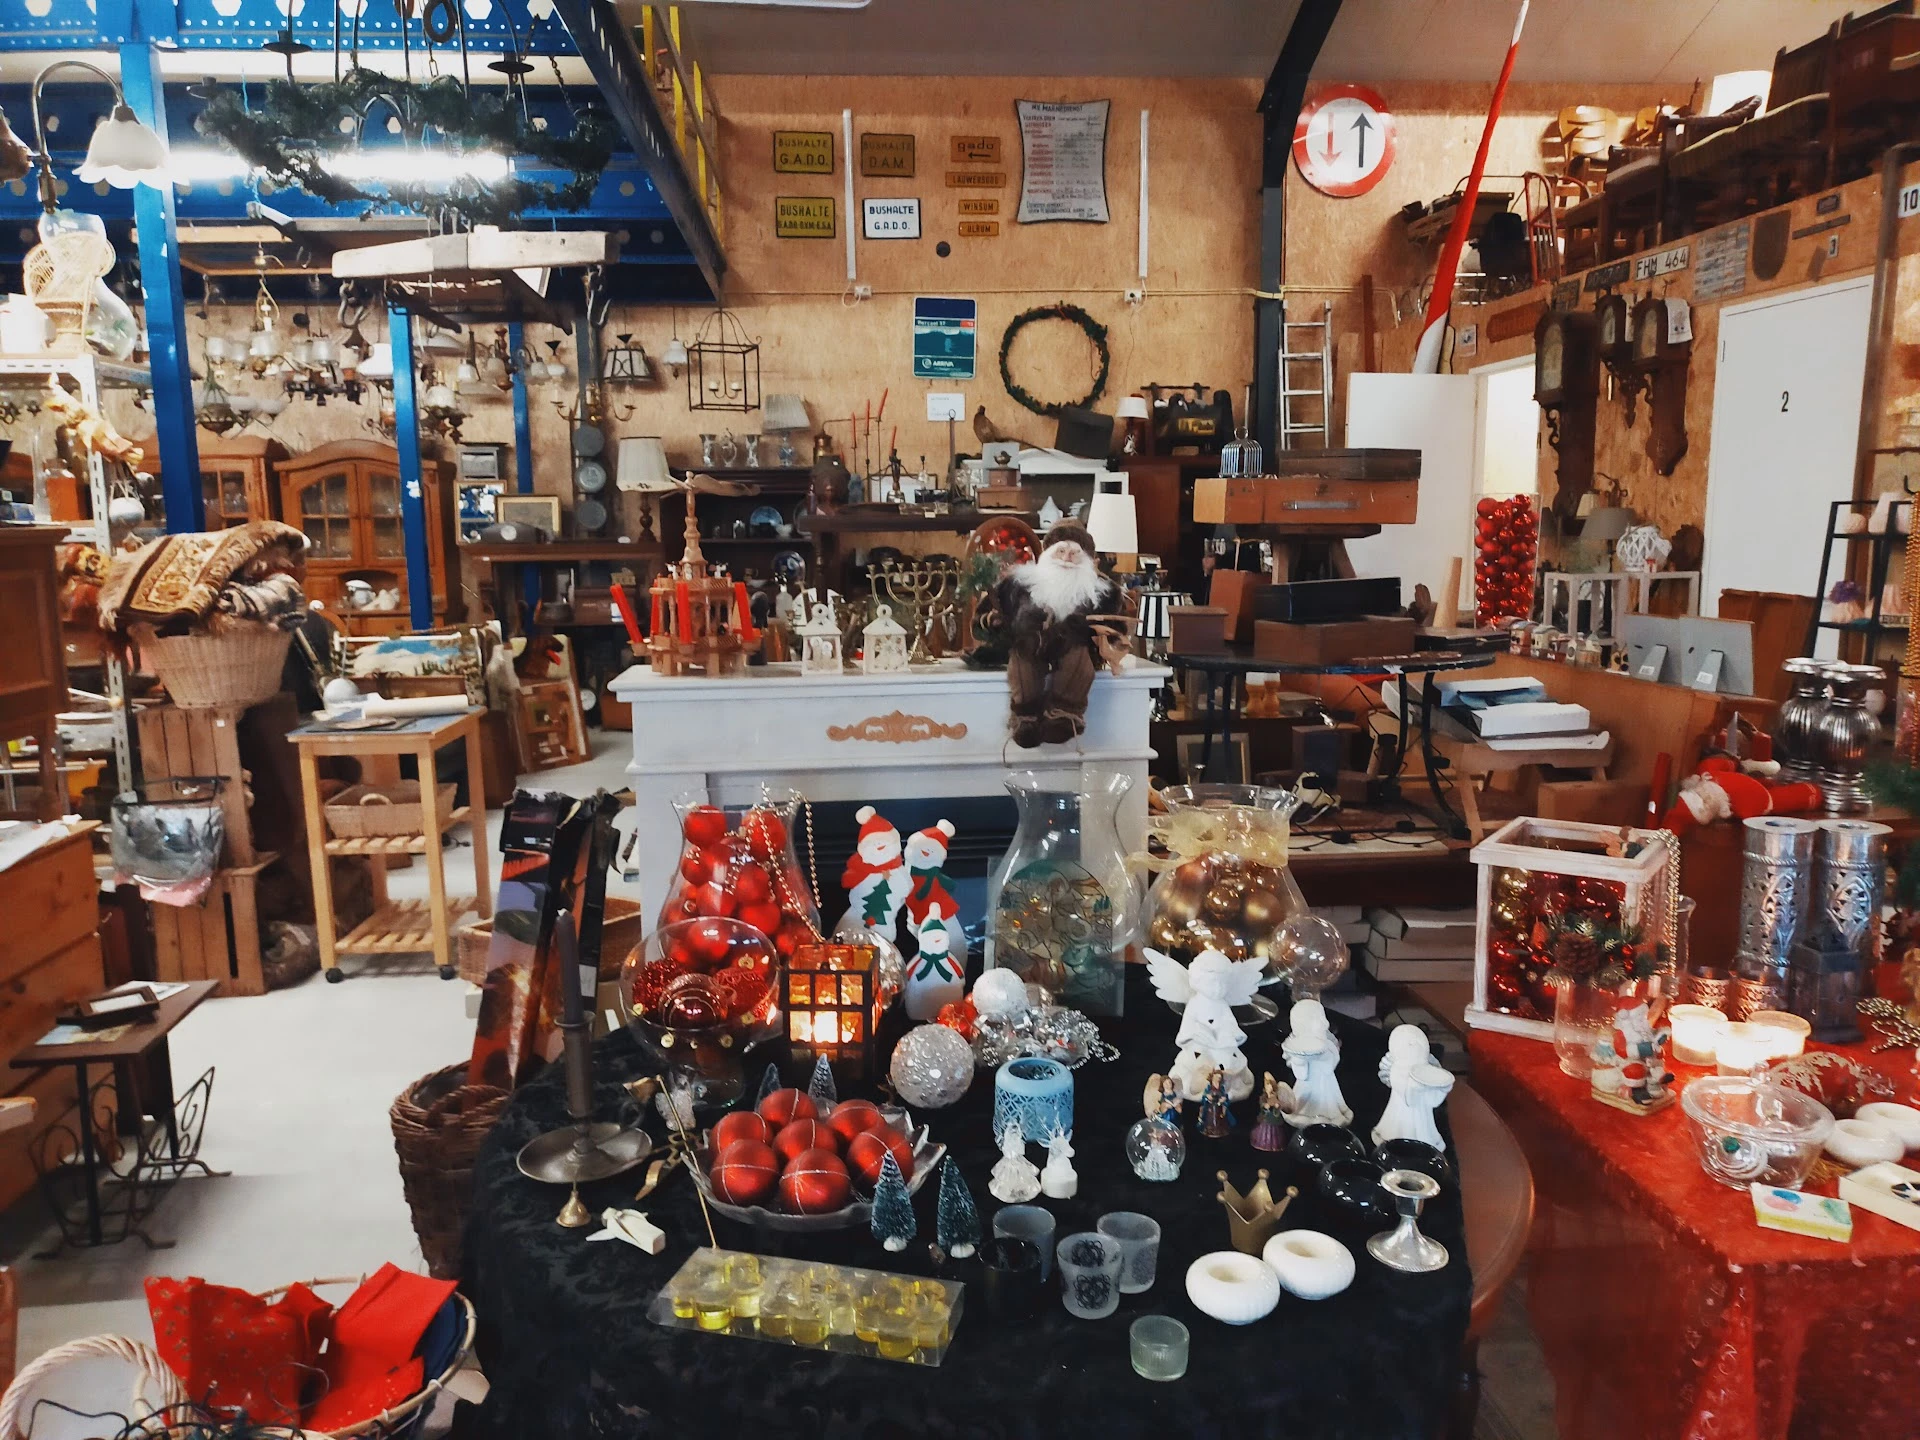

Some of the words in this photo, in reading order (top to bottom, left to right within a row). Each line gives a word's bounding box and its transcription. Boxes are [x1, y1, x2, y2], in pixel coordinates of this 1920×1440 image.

[779, 139, 828, 148] BUSHALTE
[863, 142, 912, 152] BUSHALTE
[1904, 189, 1919, 212] 10
[780, 205, 829, 217] BUSHALTE
[869, 206, 914, 215] BUSHALTE
[963, 203, 994, 211] WINSUM
[874, 221, 911, 231] G.A.D.O.
[1665, 248, 1686, 269] 464
[1781, 390, 1789, 412] 2
